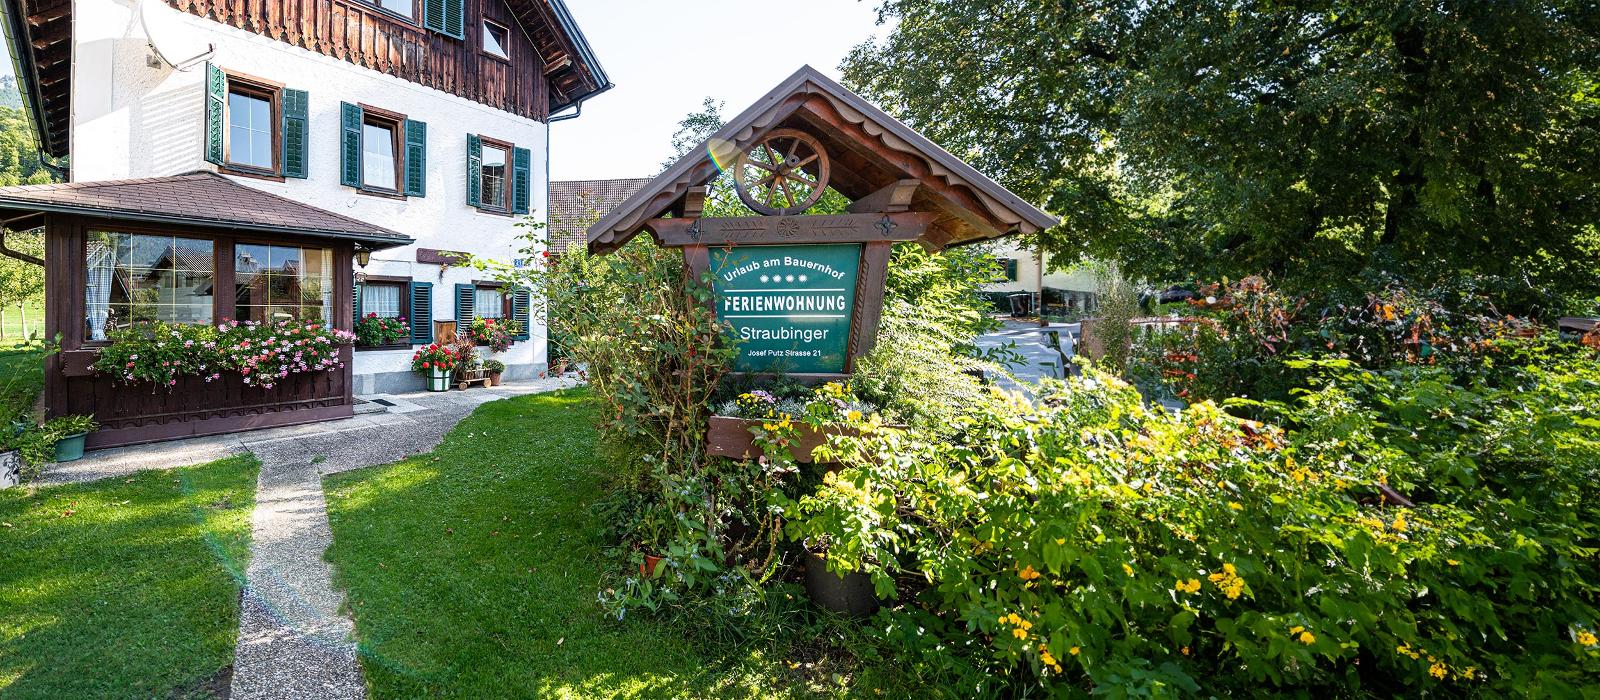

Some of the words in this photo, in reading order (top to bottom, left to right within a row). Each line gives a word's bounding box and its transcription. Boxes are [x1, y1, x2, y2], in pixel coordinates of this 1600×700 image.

[724, 261, 760, 282] Urlaub
[763, 258, 781, 268] am
[784, 256, 846, 280] Bauernhof
[724, 295, 846, 312] FERIENWOHNUNG
[740, 326, 829, 343] Straubinger
[812, 349, 822, 357] 21
